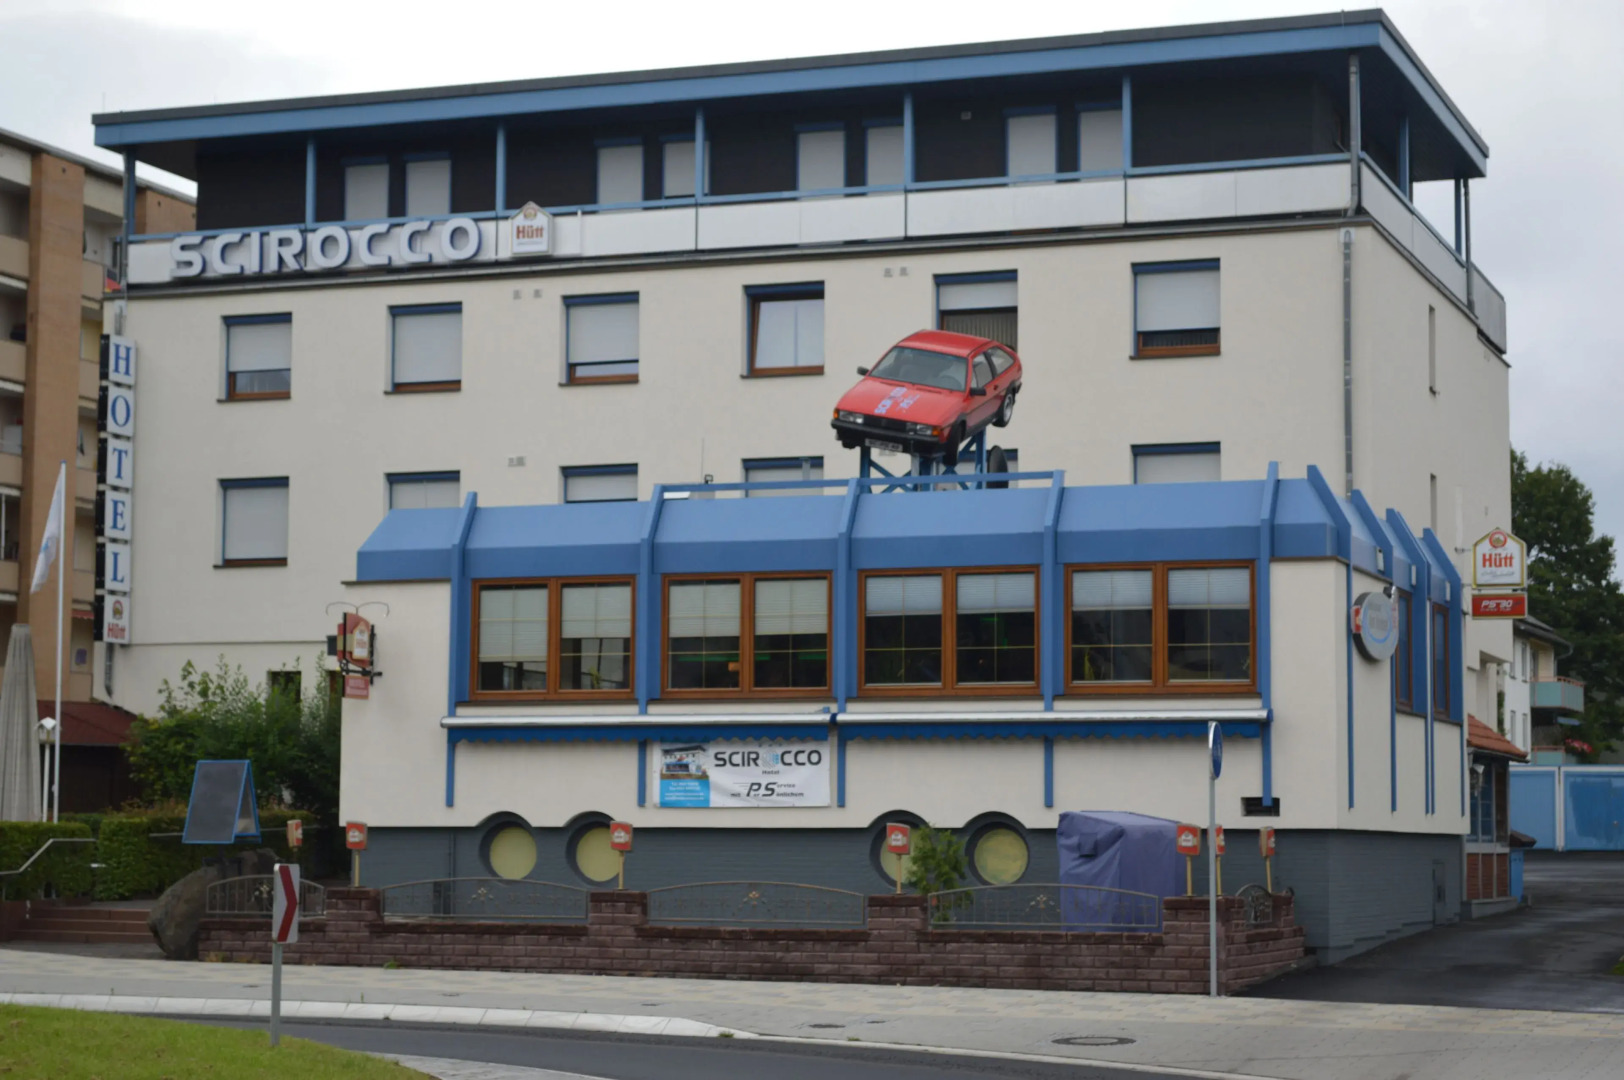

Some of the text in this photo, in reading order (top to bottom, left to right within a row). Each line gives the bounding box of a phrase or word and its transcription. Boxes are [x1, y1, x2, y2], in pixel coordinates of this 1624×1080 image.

[169, 217, 481, 280] SCIROCCO
[515, 224, 544, 240] Hütt
[110, 343, 132, 583] HOTEL
[1482, 552, 1514, 568] Hütt
